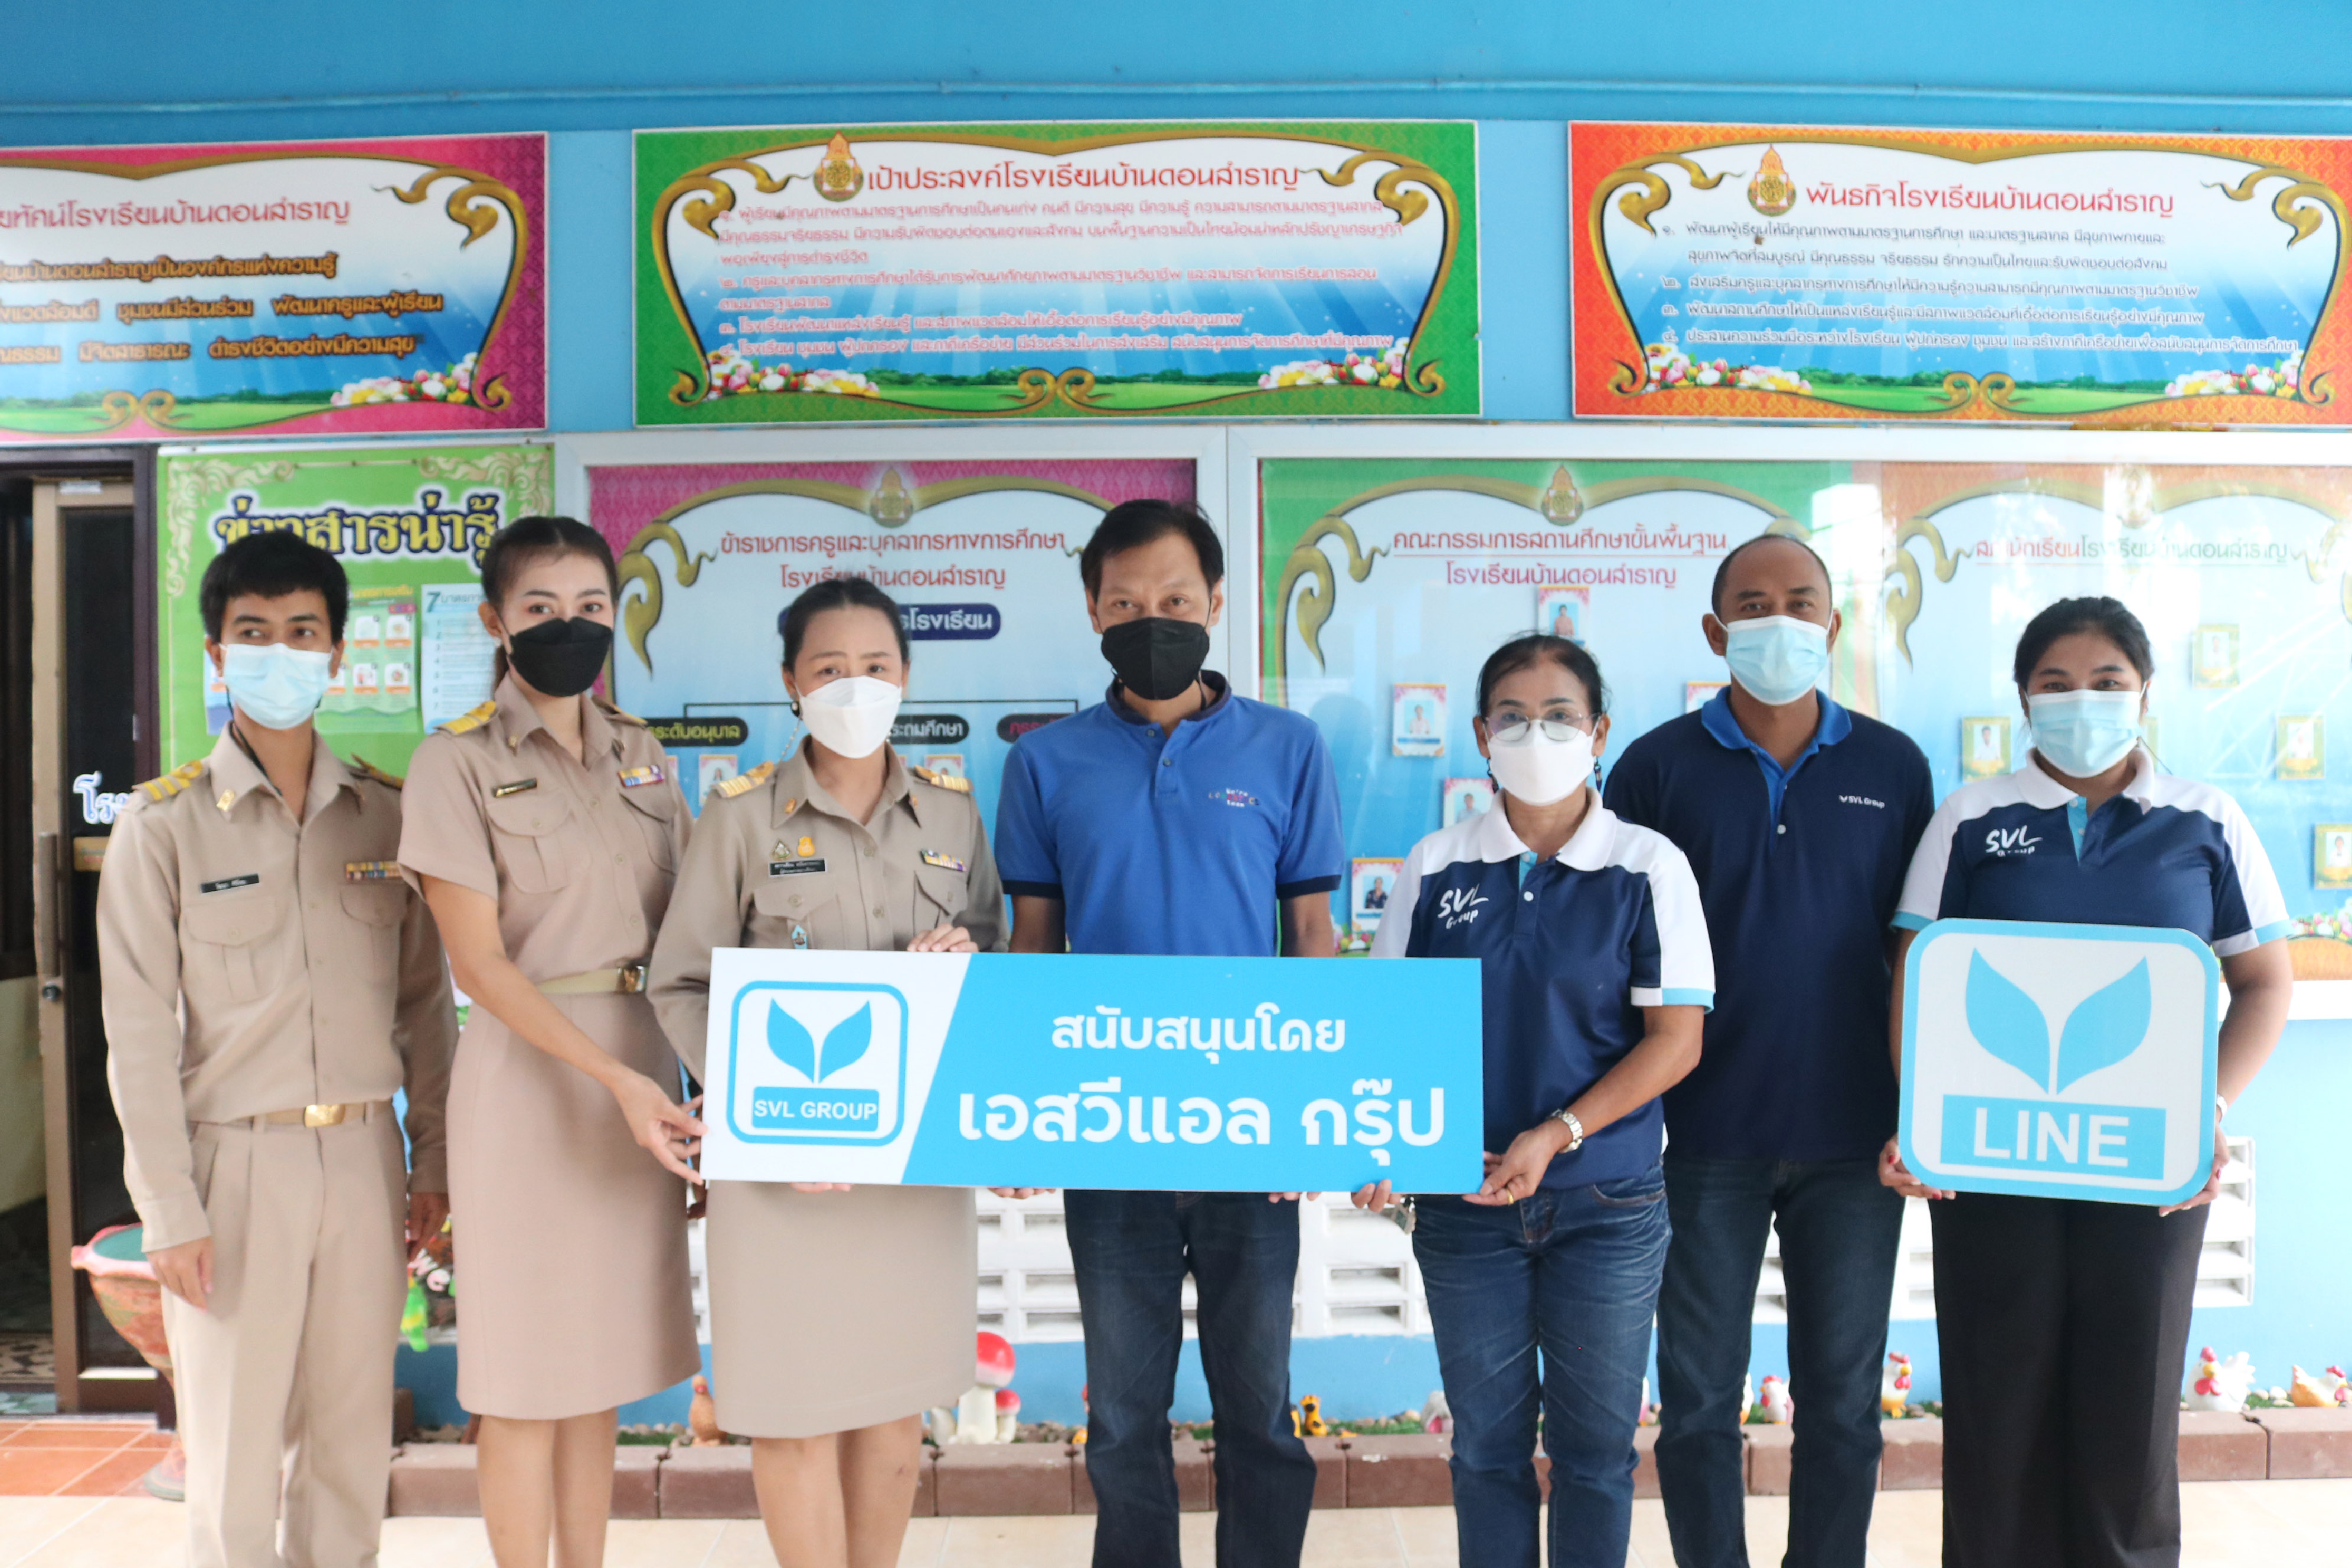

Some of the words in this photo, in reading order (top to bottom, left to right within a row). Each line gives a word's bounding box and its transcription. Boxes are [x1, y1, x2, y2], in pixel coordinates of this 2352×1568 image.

[868, 161, 1298, 191] เป้าประสงค์โรงเรียนบ้านดอนสำราญ
[1807, 181, 2174, 218] พันธกิจโรงเรียนบ้านดอนสำราญ
[721, 527, 1065, 558] ข้าราชการครูและบุคลากรทางการศึกษา
[1394, 523, 1727, 555] คณะกรรมการสถานศึกษาขั้นพื้นฐาน
[1446, 560, 1676, 588] โรงเรียนบ้านดอนสำราญ
[1985, 825, 2043, 853] SVL
[1438, 883, 1489, 918] SVL
[1051, 1002, 1345, 1064] สนับสนุนโดย
[754, 1100, 795, 1117] SVL
[800, 1101, 877, 1121] GROUP
[958, 1076, 1271, 1145] เอสวีแอล
[1301, 1079, 1444, 1167] กรุ๊ป
[1974, 1107, 2130, 1168] LINE
